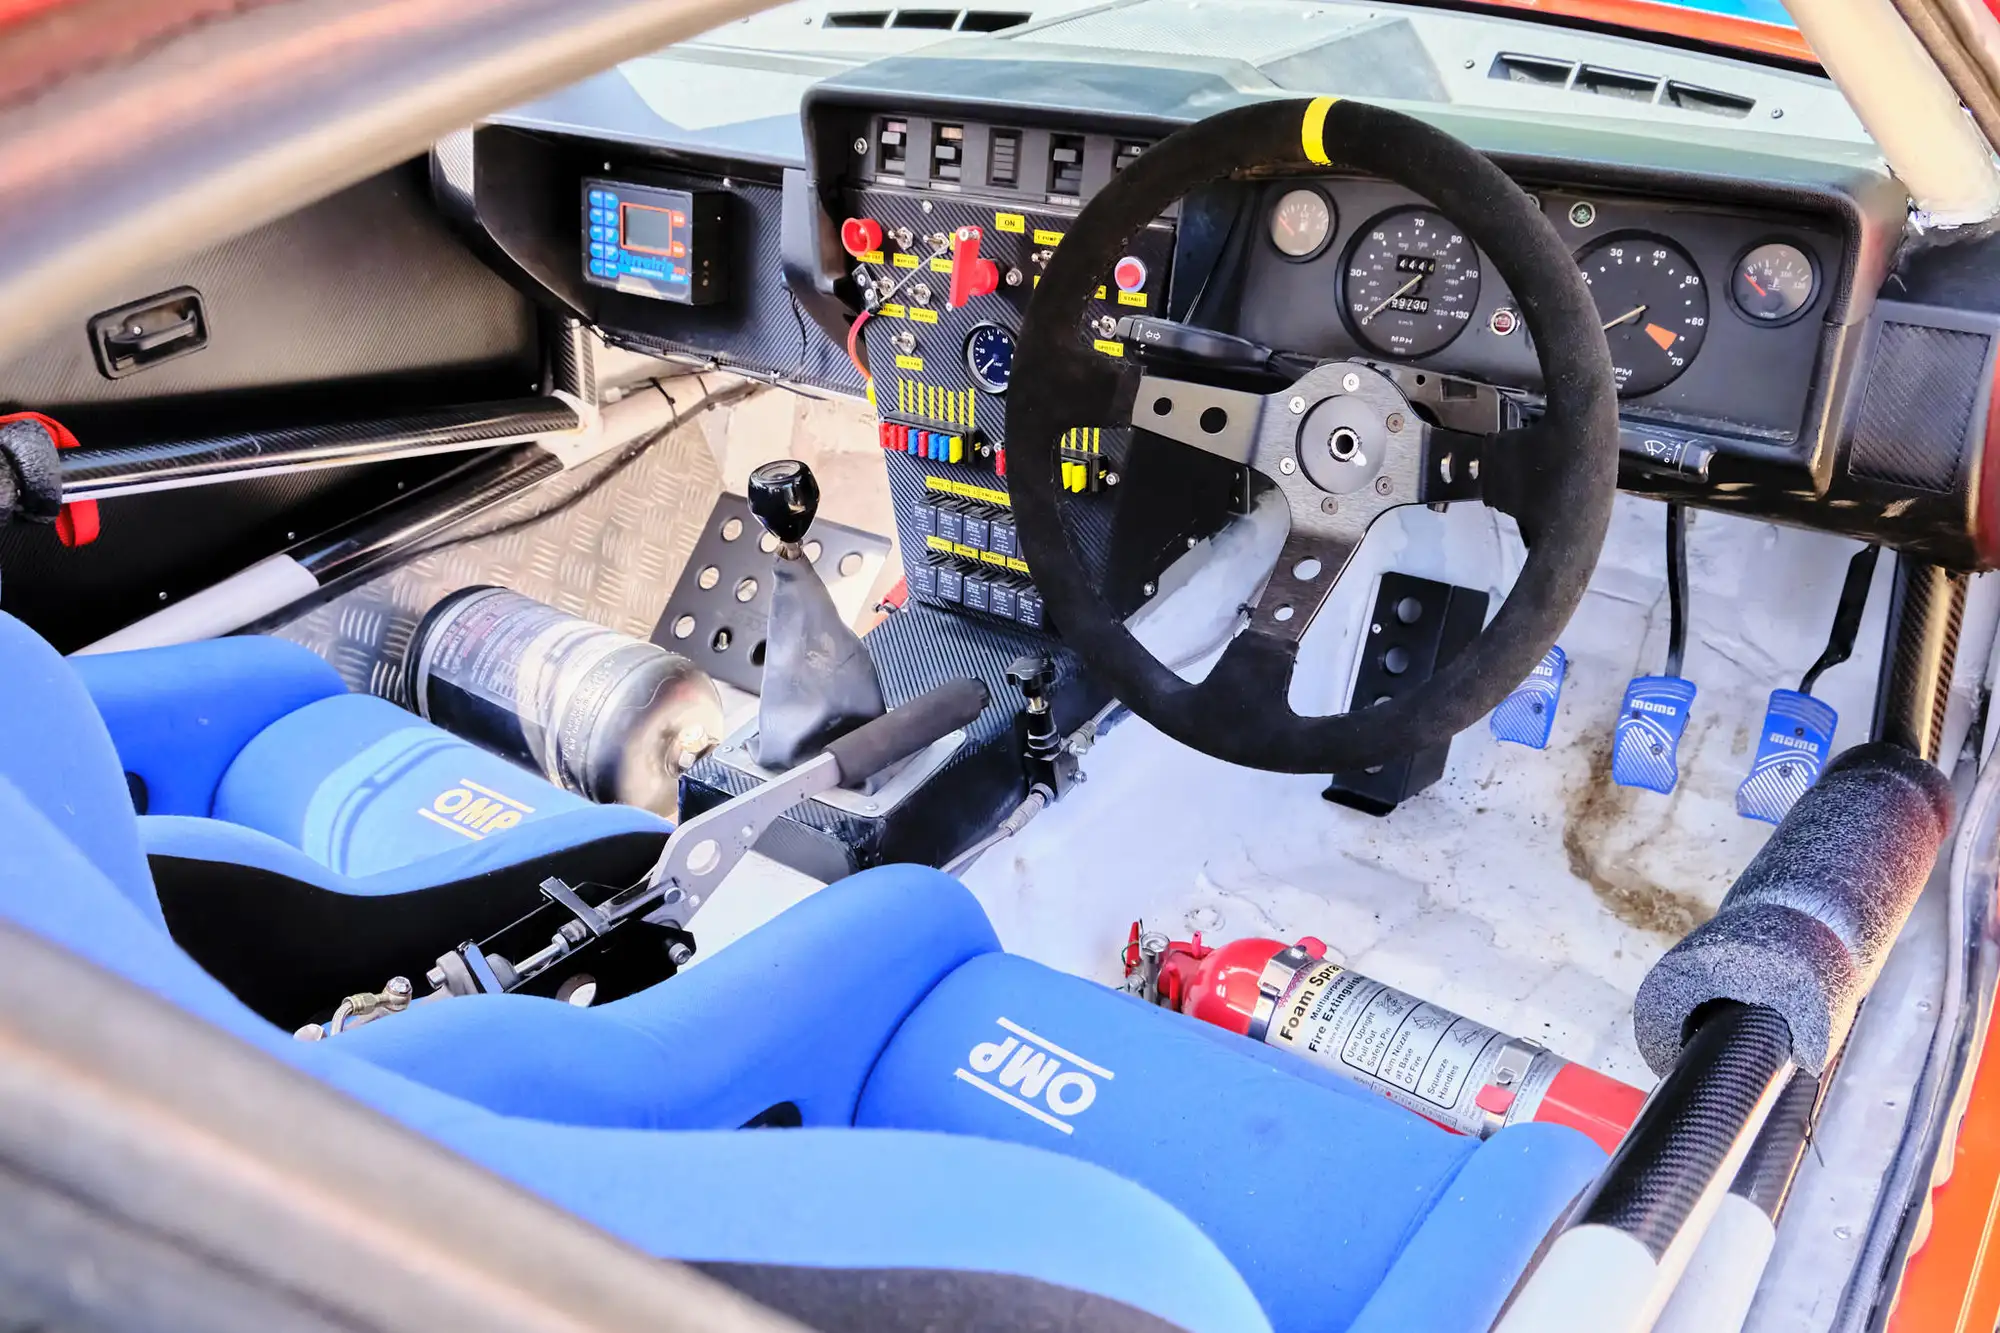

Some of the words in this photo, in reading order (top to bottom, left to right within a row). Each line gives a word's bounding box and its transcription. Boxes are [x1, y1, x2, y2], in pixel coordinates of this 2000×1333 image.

[1004, 219, 1016, 227] ON
[1414, 218, 1425, 227] 70
[1610, 248, 1624, 257] 30
[1653, 250, 1667, 260] 40
[1349, 268, 1362, 277] 30
[1465, 269, 1479, 279] 110
[1685, 276, 1699, 285] 50
[1353, 303, 1363, 312] 10
[1455, 310, 1469, 320] 130
[1361, 317, 1368, 326] 0
[1691, 318, 1705, 327] 60
[1390, 335, 1413, 345] MPH
[1671, 357, 1684, 366] 70
[1612, 366, 1633, 377] PM
[1531, 665, 1553, 677] mo
[1630, 698, 1677, 717] momo
[1769, 732, 1819, 753] momo
[433, 788, 523, 834] OMP
[1310, 975, 1348, 1021] Multipurpose
[1279, 990, 1315, 1041] Foam
[1308, 1025, 1327, 1053] Fire
[1347, 1040, 1360, 1058] Use
[1355, 1012, 1376, 1040] Upright
[1357, 1044, 1370, 1063] Pull
[1365, 1029, 1378, 1045] Out
[1367, 1040, 1386, 1067] Safety
[1380, 1027, 1392, 1041] Pin
[1384, 1056, 1397, 1076] Aim
[1392, 1030, 1412, 1057] Nozzle
[1395, 1068, 1405, 1080] at
[1401, 1048, 1414, 1068] Base
[1404, 1071, 1416, 1085] Of
[1410, 1055, 1423, 1073] Fire
[968, 1035, 1097, 1117] OMP
[1427, 1058, 1449, 1095] Squeeze
[1437, 1065, 1460, 1100] Handles
